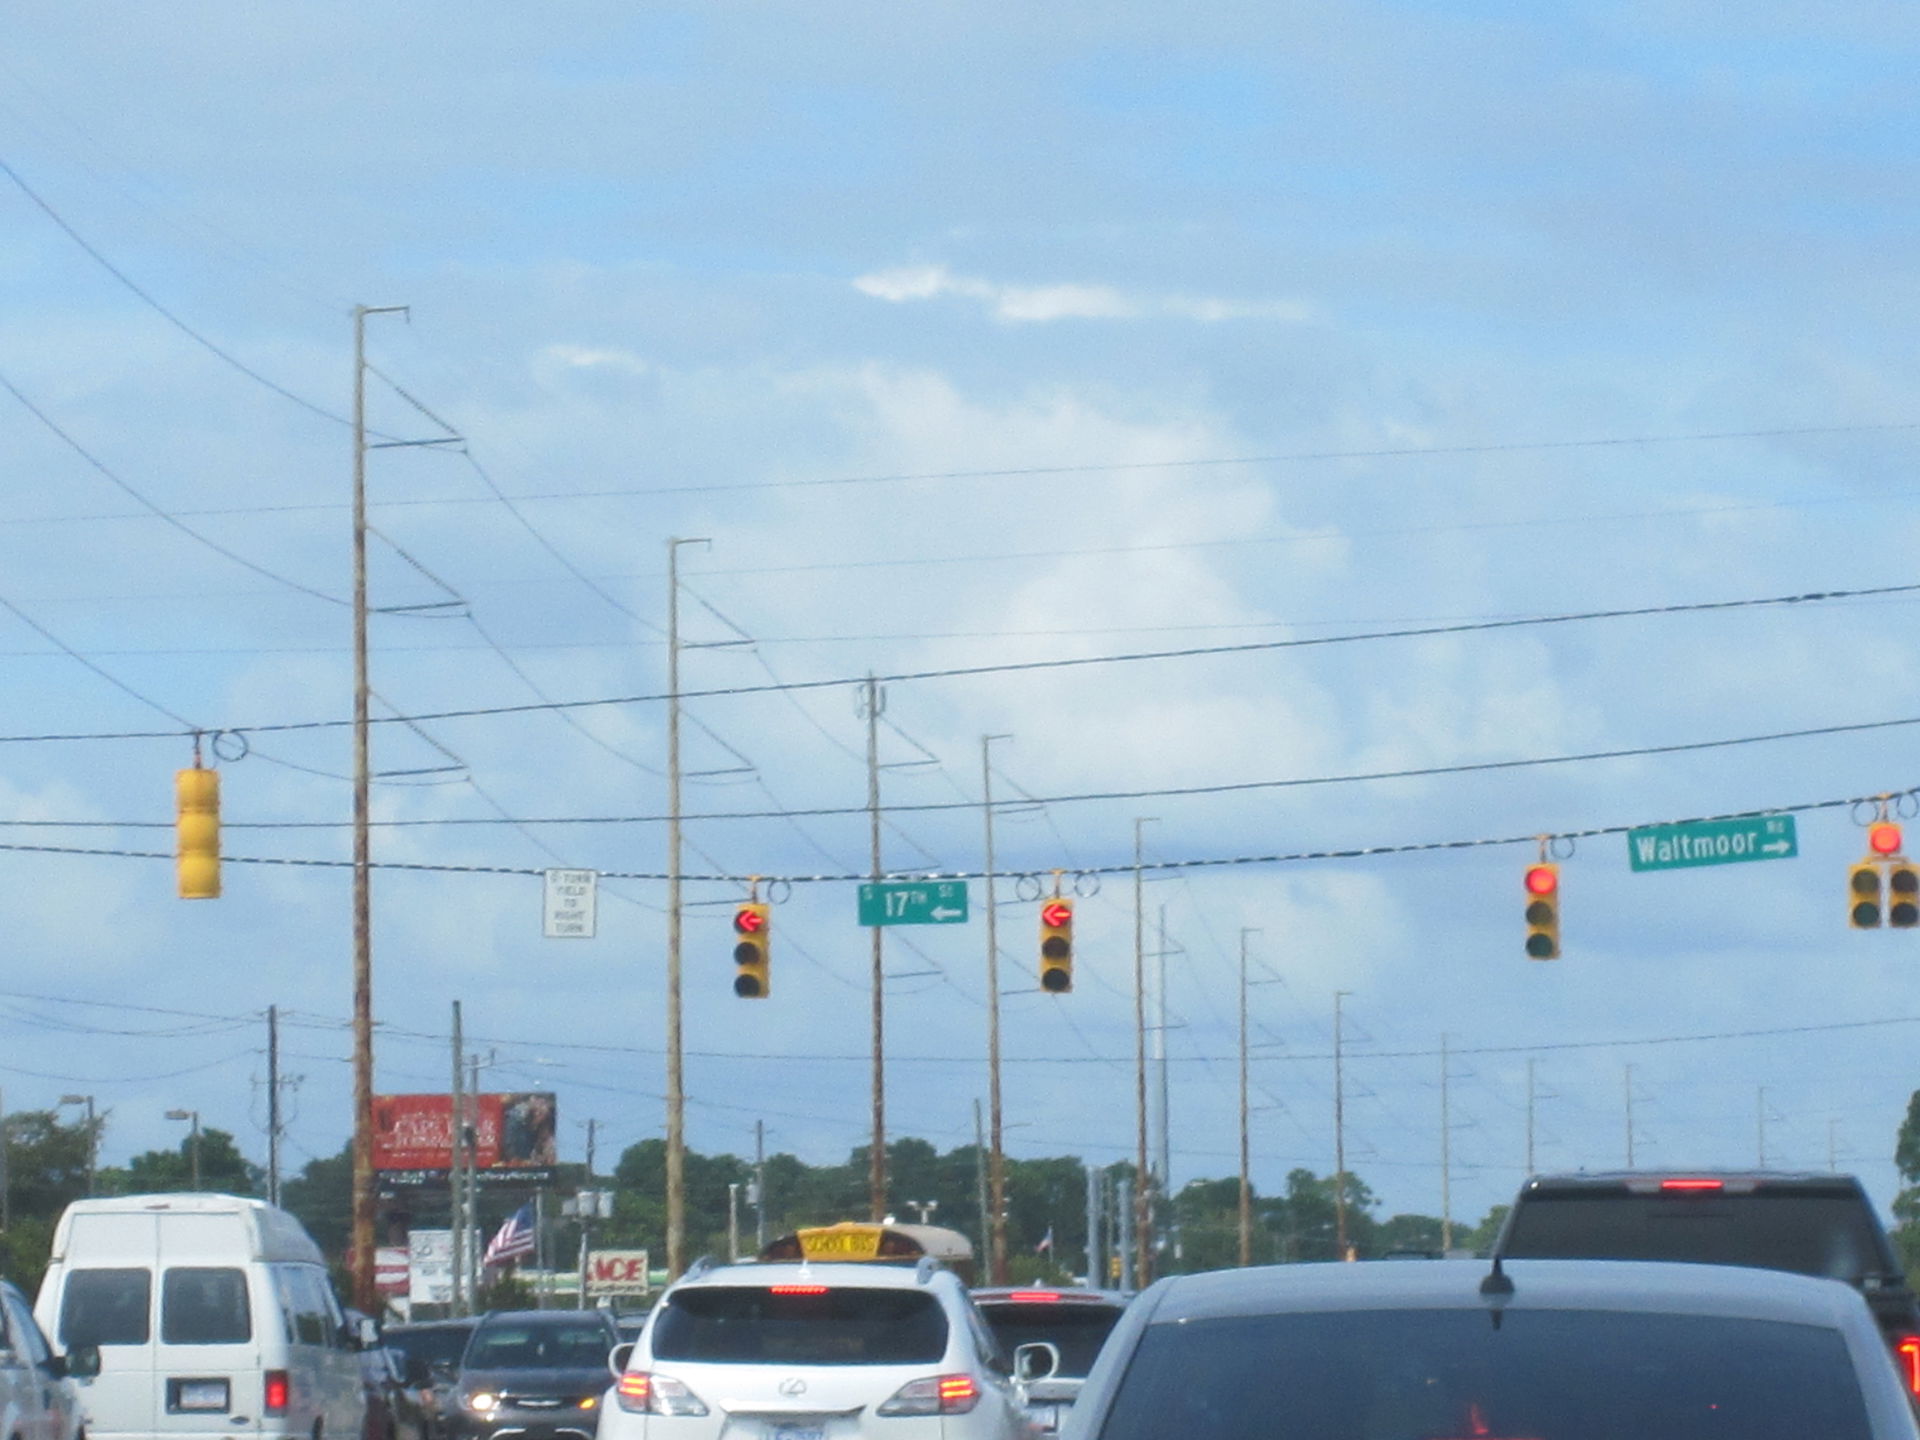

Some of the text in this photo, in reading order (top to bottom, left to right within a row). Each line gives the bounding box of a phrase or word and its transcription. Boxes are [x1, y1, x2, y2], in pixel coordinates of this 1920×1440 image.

[1635, 832, 1757, 863] Waltmoor
[557, 886, 586, 896] YIELD
[563, 899, 577, 908] TO
[555, 911, 586, 920] RIGHT
[555, 922, 583, 933] TURN
[805, 1234, 875, 1252] SCHOOL BUS
